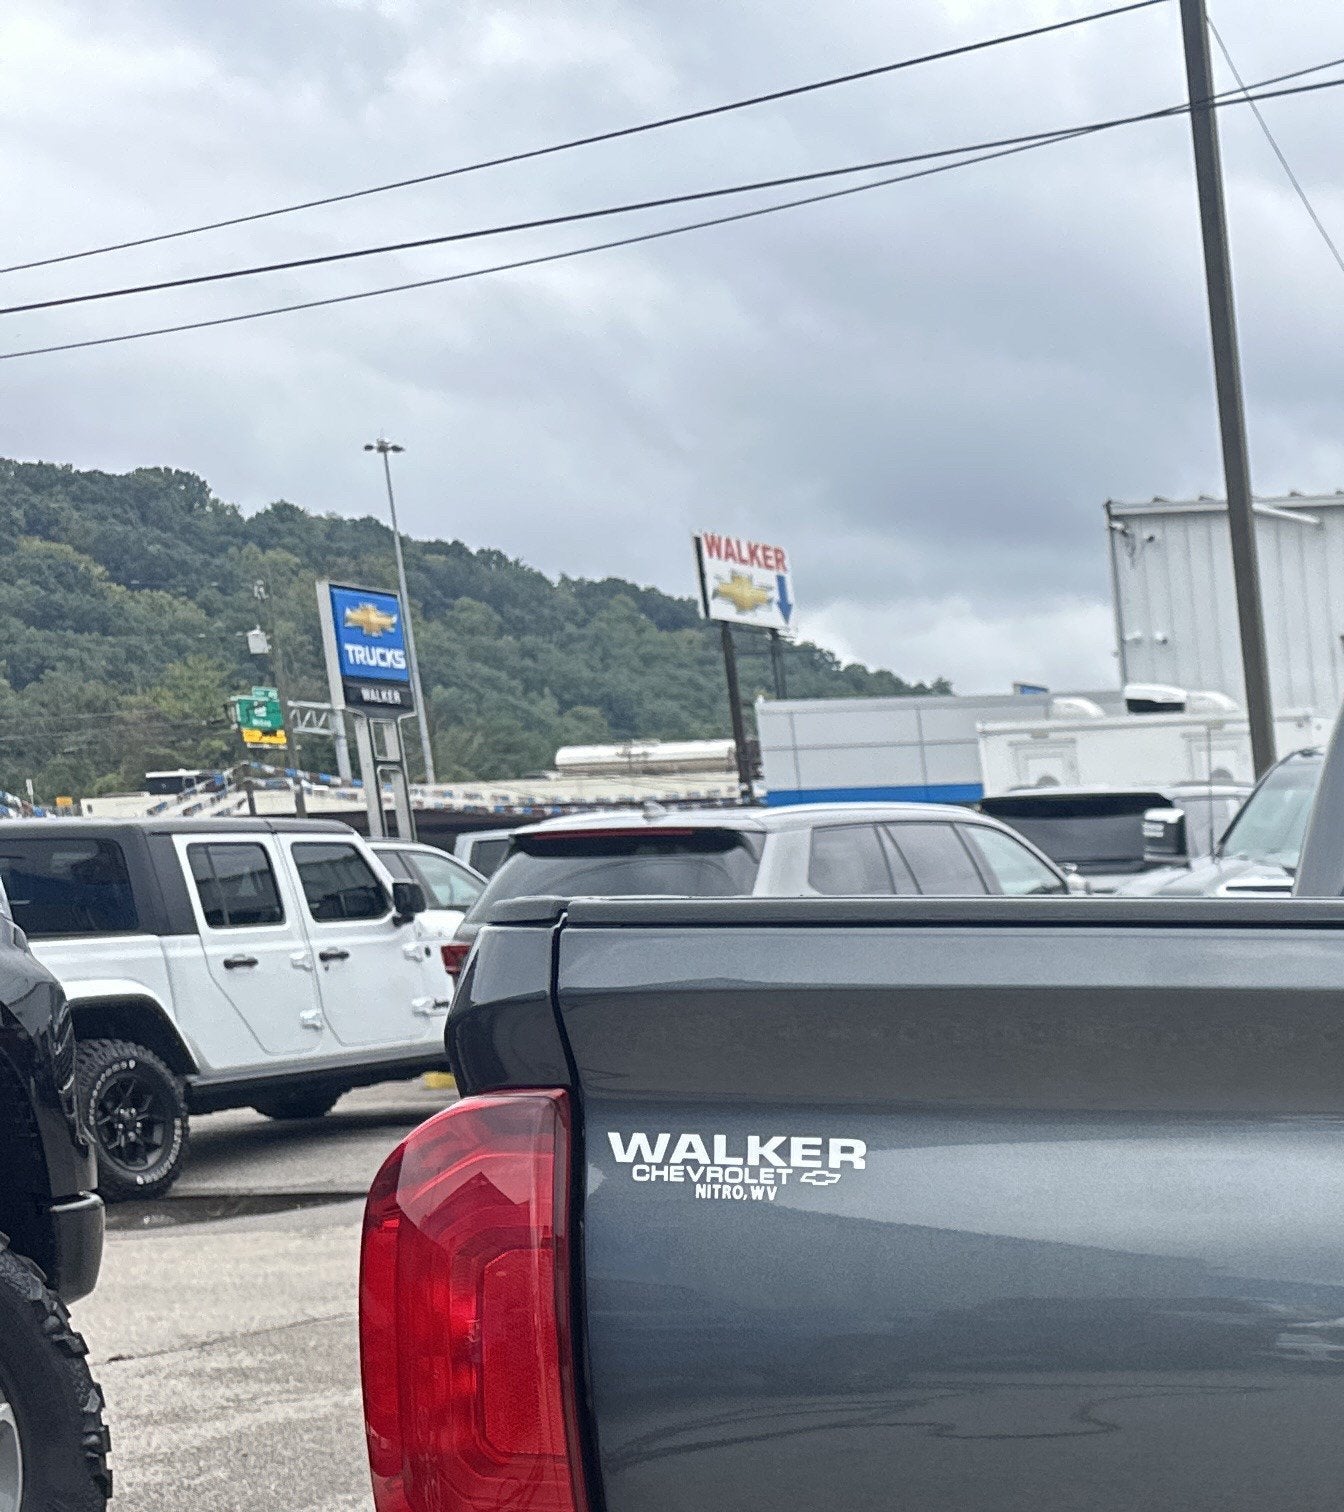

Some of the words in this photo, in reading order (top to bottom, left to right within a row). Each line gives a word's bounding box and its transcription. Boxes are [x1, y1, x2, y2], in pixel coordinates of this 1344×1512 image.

[703, 532, 788, 574] WALKER
[344, 643, 406, 669] TRUCKS
[361, 687, 401, 704] WALKER
[607, 1131, 867, 1169] WALKER
[632, 1164, 793, 1184] CHEVROLET
